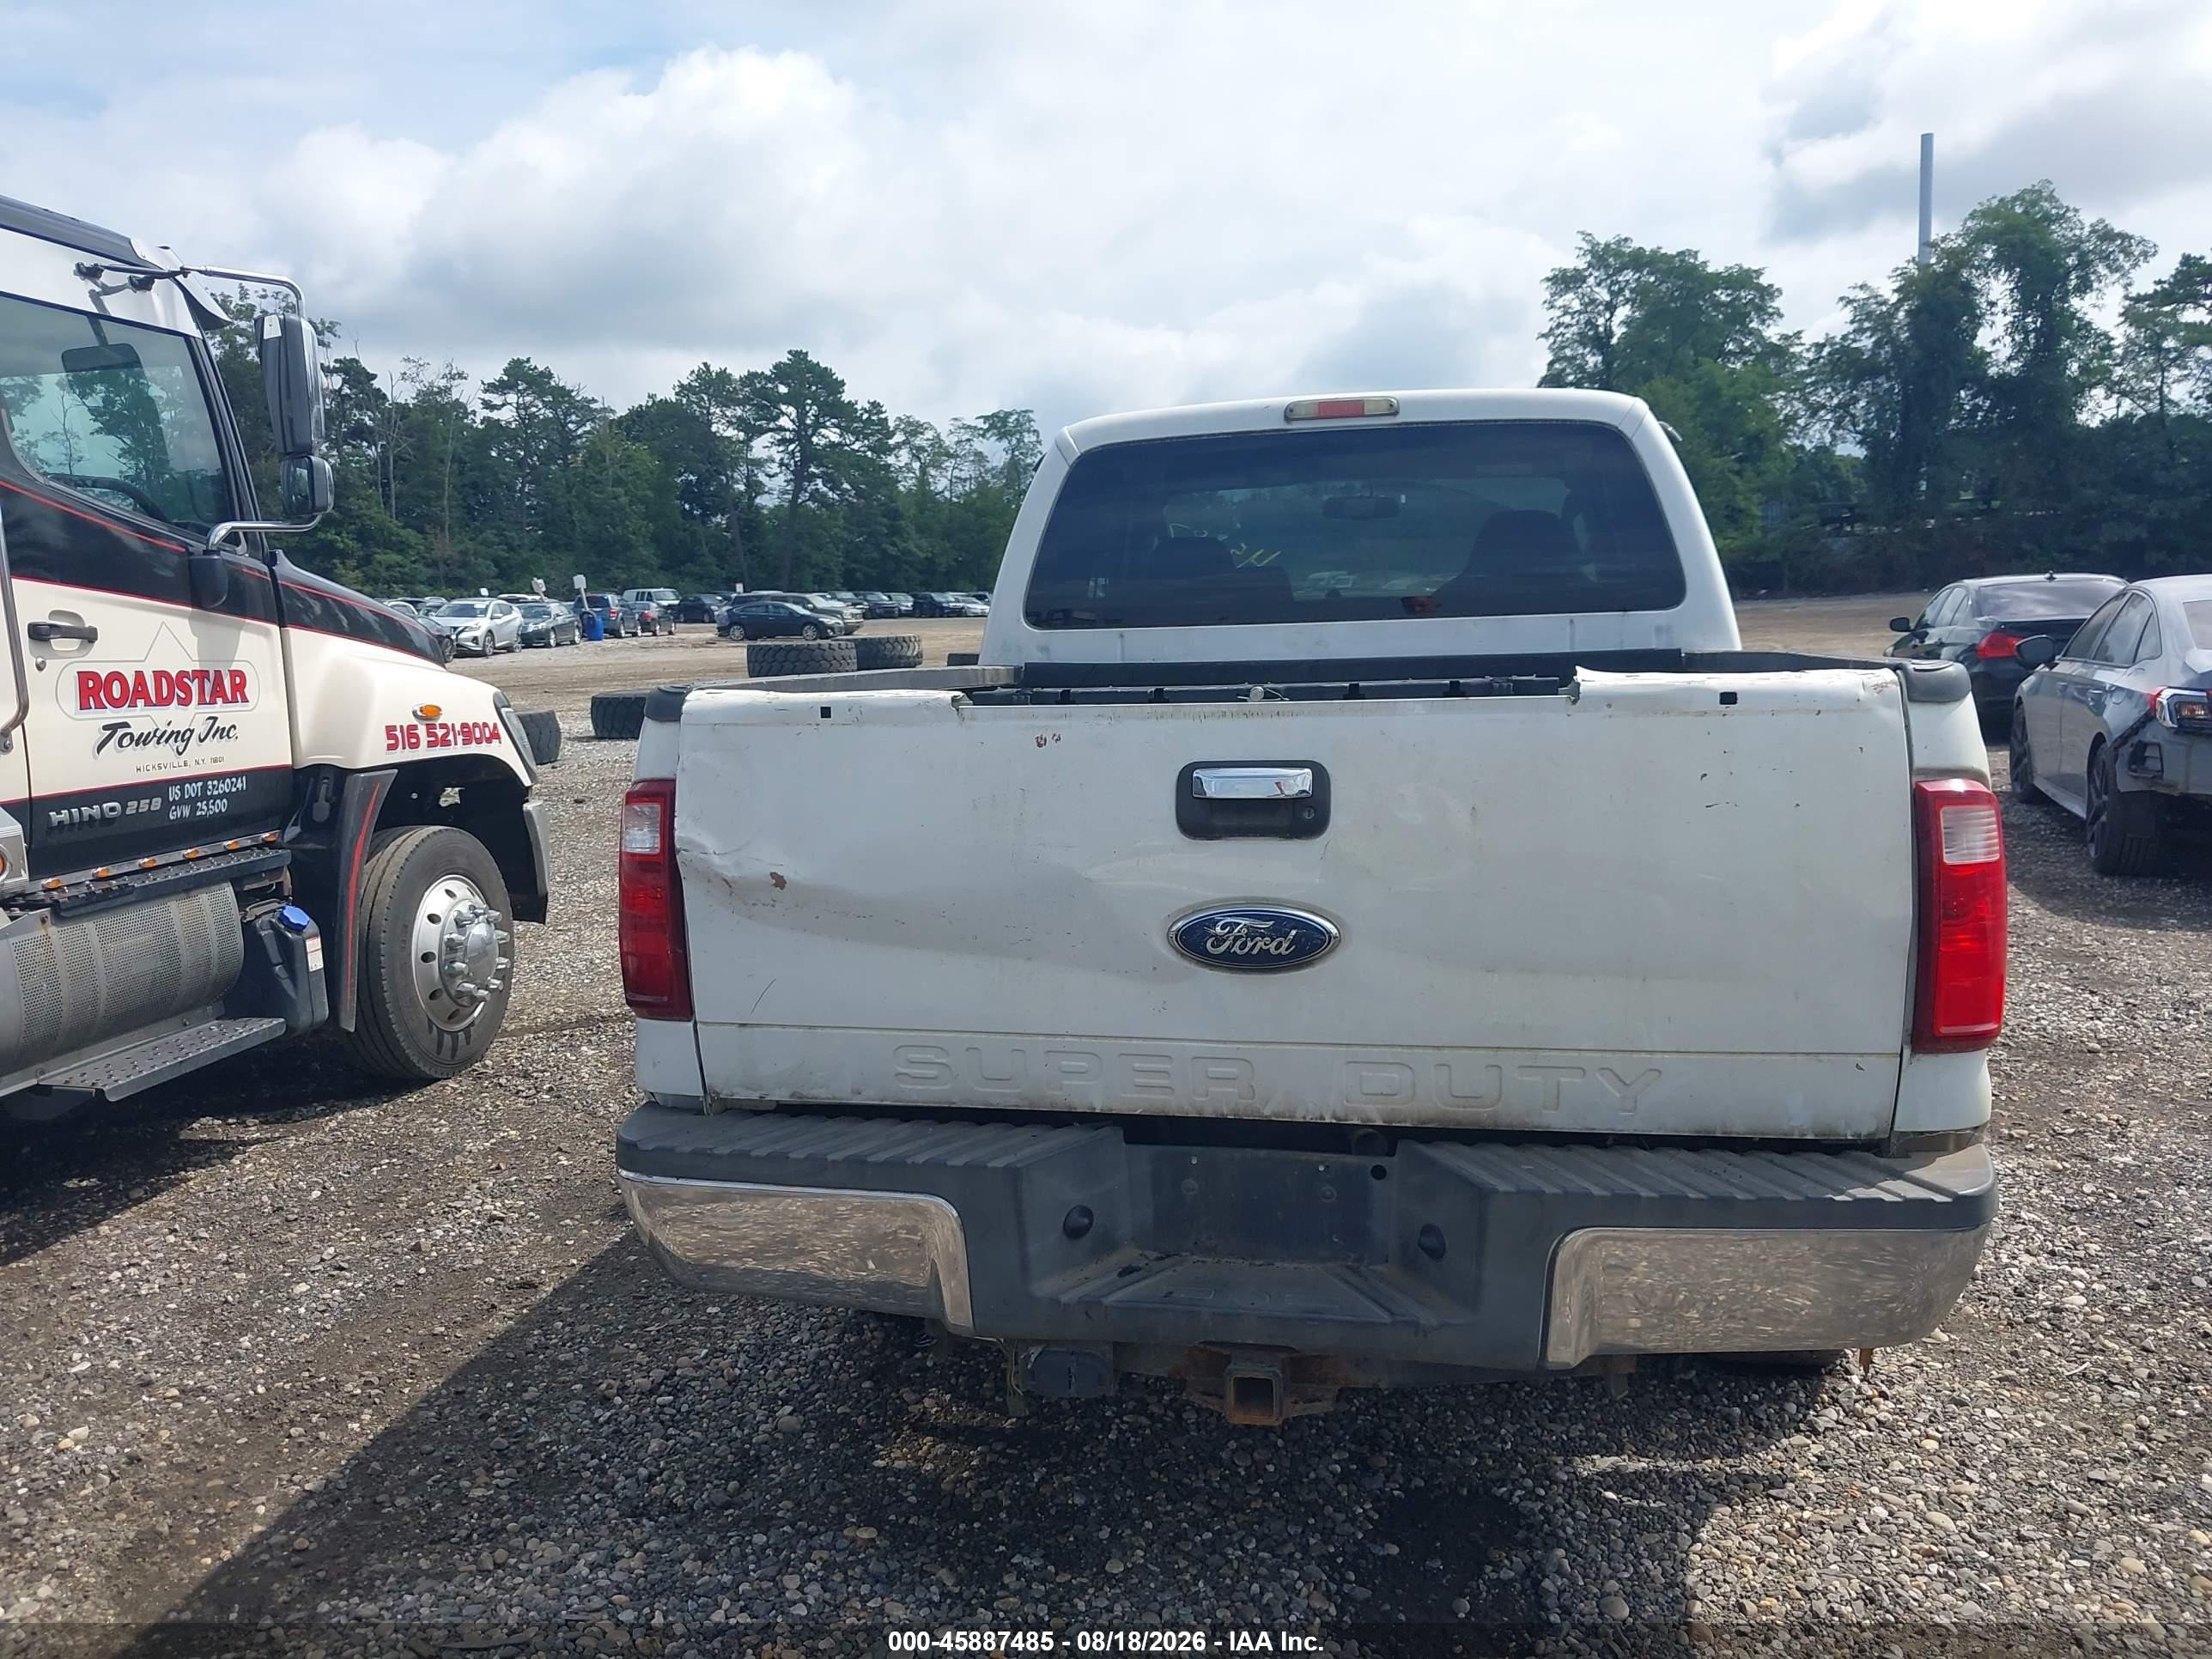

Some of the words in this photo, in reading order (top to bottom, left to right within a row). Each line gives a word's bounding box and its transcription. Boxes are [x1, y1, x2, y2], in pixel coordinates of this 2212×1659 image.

[76, 670, 250, 710] ROADSTAR
[96, 720, 195, 756] Towing
[198, 715, 239, 744] Inc.
[385, 724, 421, 750] 516
[426, 722, 501, 748] 521-9004
[136, 760, 191, 772] HICKSVILLE,
[168, 785, 181, 802] US
[184, 781, 204, 799] DOT
[206, 775, 246, 796] 3260241
[49, 802, 122, 826] HINO
[125, 797, 162, 815] 258
[169, 804, 191, 820] GVW
[196, 799, 228, 817] 25,500
[1203, 915, 1296, 955] Ford
[893, 1044, 1257, 1103] SUPER
[1344, 1060, 1663, 1115] DUTY
